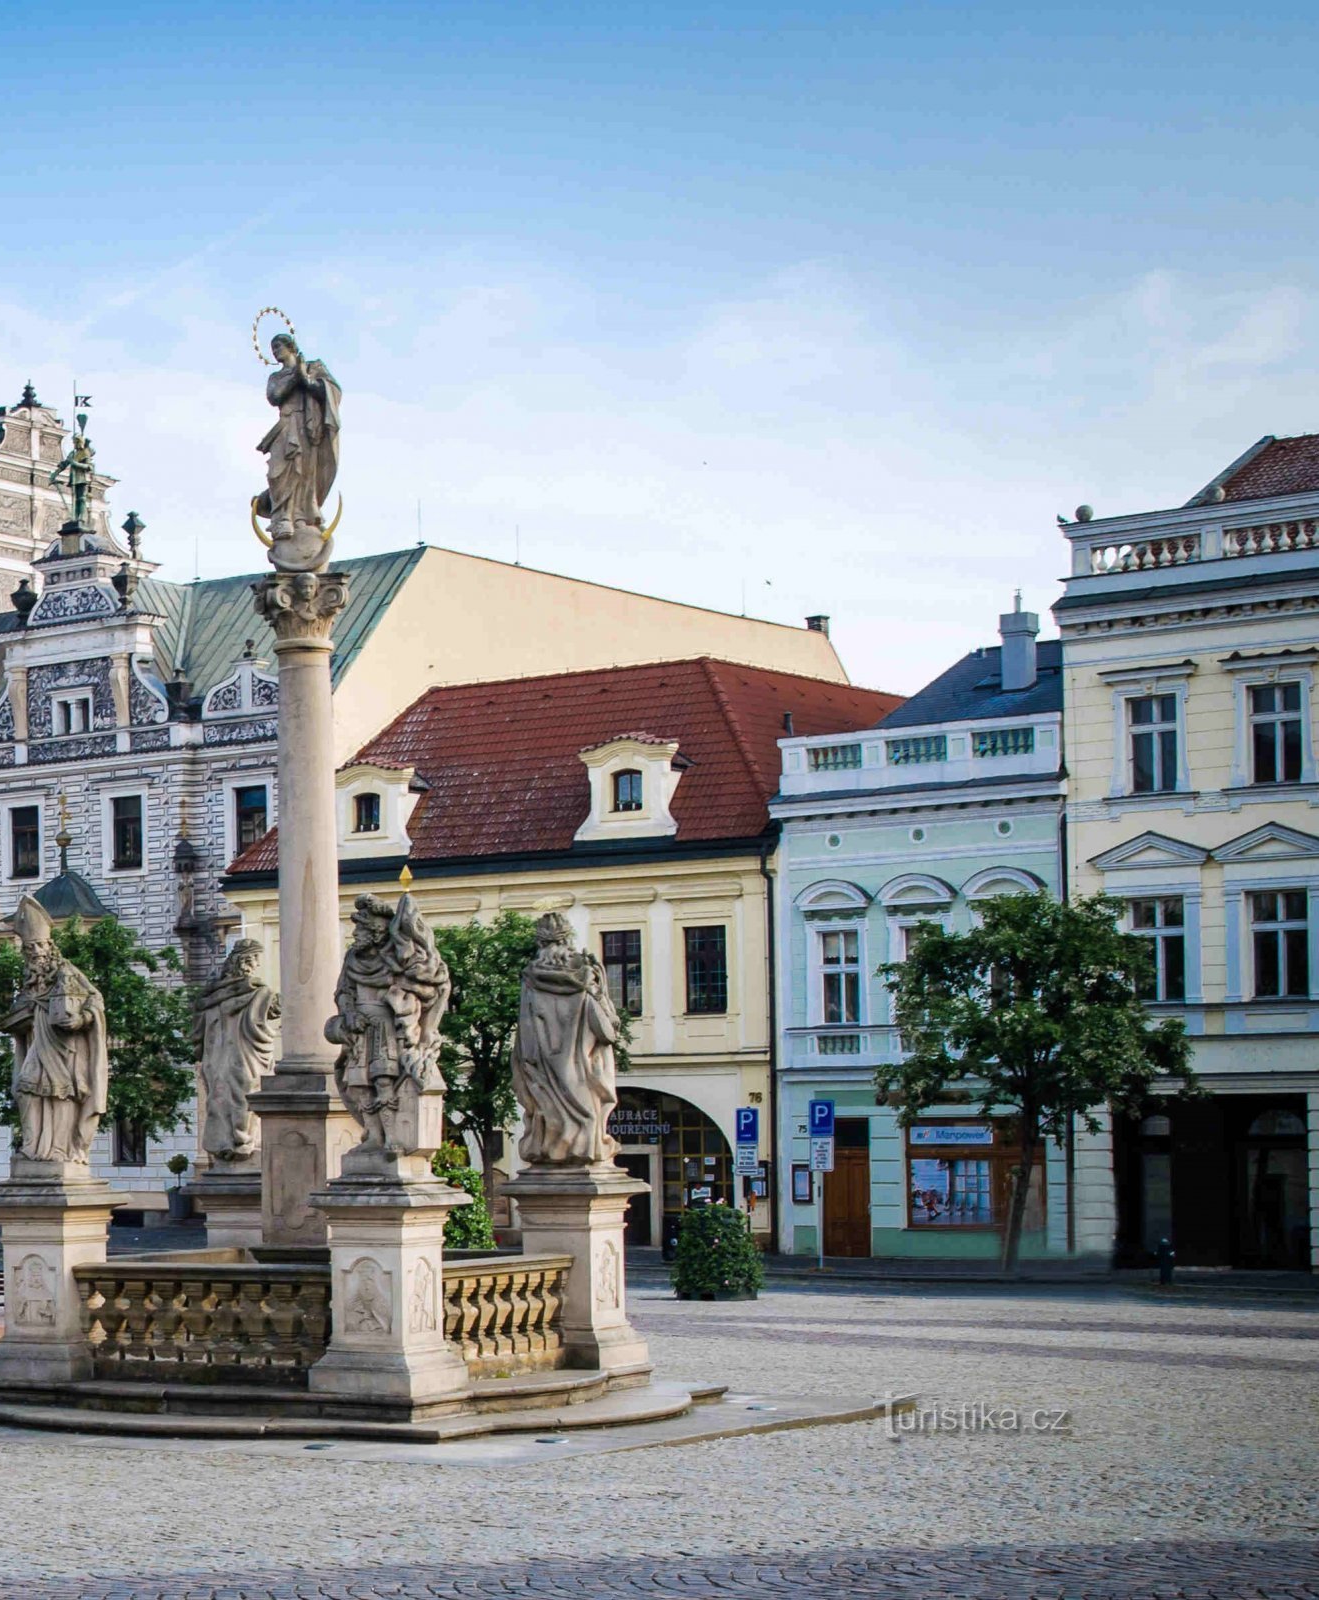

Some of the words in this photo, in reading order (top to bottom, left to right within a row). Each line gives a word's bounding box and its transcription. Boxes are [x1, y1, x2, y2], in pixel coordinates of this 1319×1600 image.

[748, 1092, 763, 1104] 76
[609, 1110, 658, 1121] AURACE
[816, 1105, 828, 1125] P
[741, 1111, 753, 1131] P
[798, 1124, 807, 1134] 75
[936, 1130, 985, 1141] Manpower
